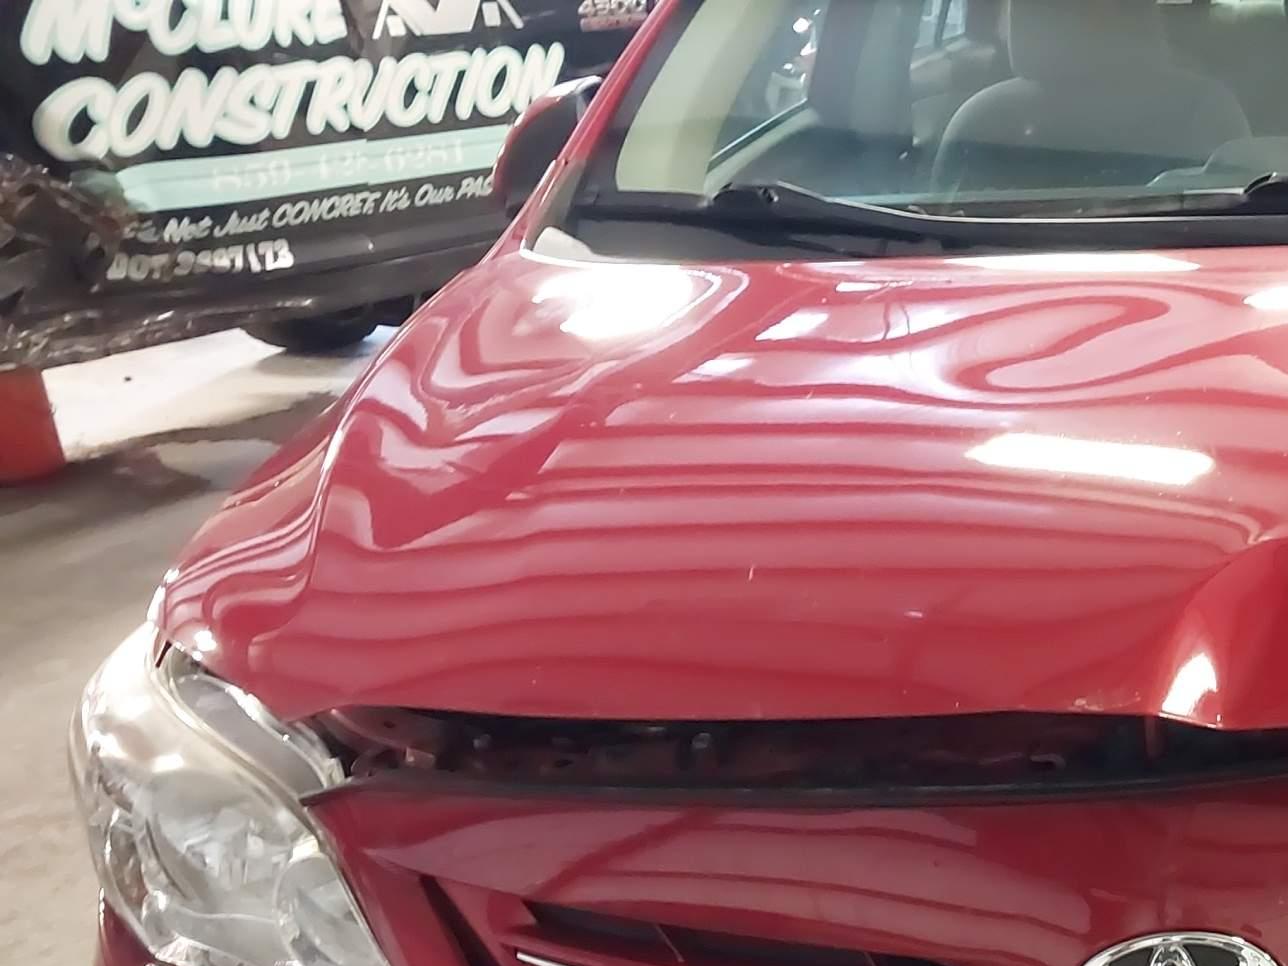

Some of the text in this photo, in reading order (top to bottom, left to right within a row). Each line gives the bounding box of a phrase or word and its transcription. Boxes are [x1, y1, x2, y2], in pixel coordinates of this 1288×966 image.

[32, 42, 565, 162] CONSTRUCTION
[162, 215, 214, 245] Not
[213, 209, 272, 238] Just
[414, 182, 454, 207] Our
